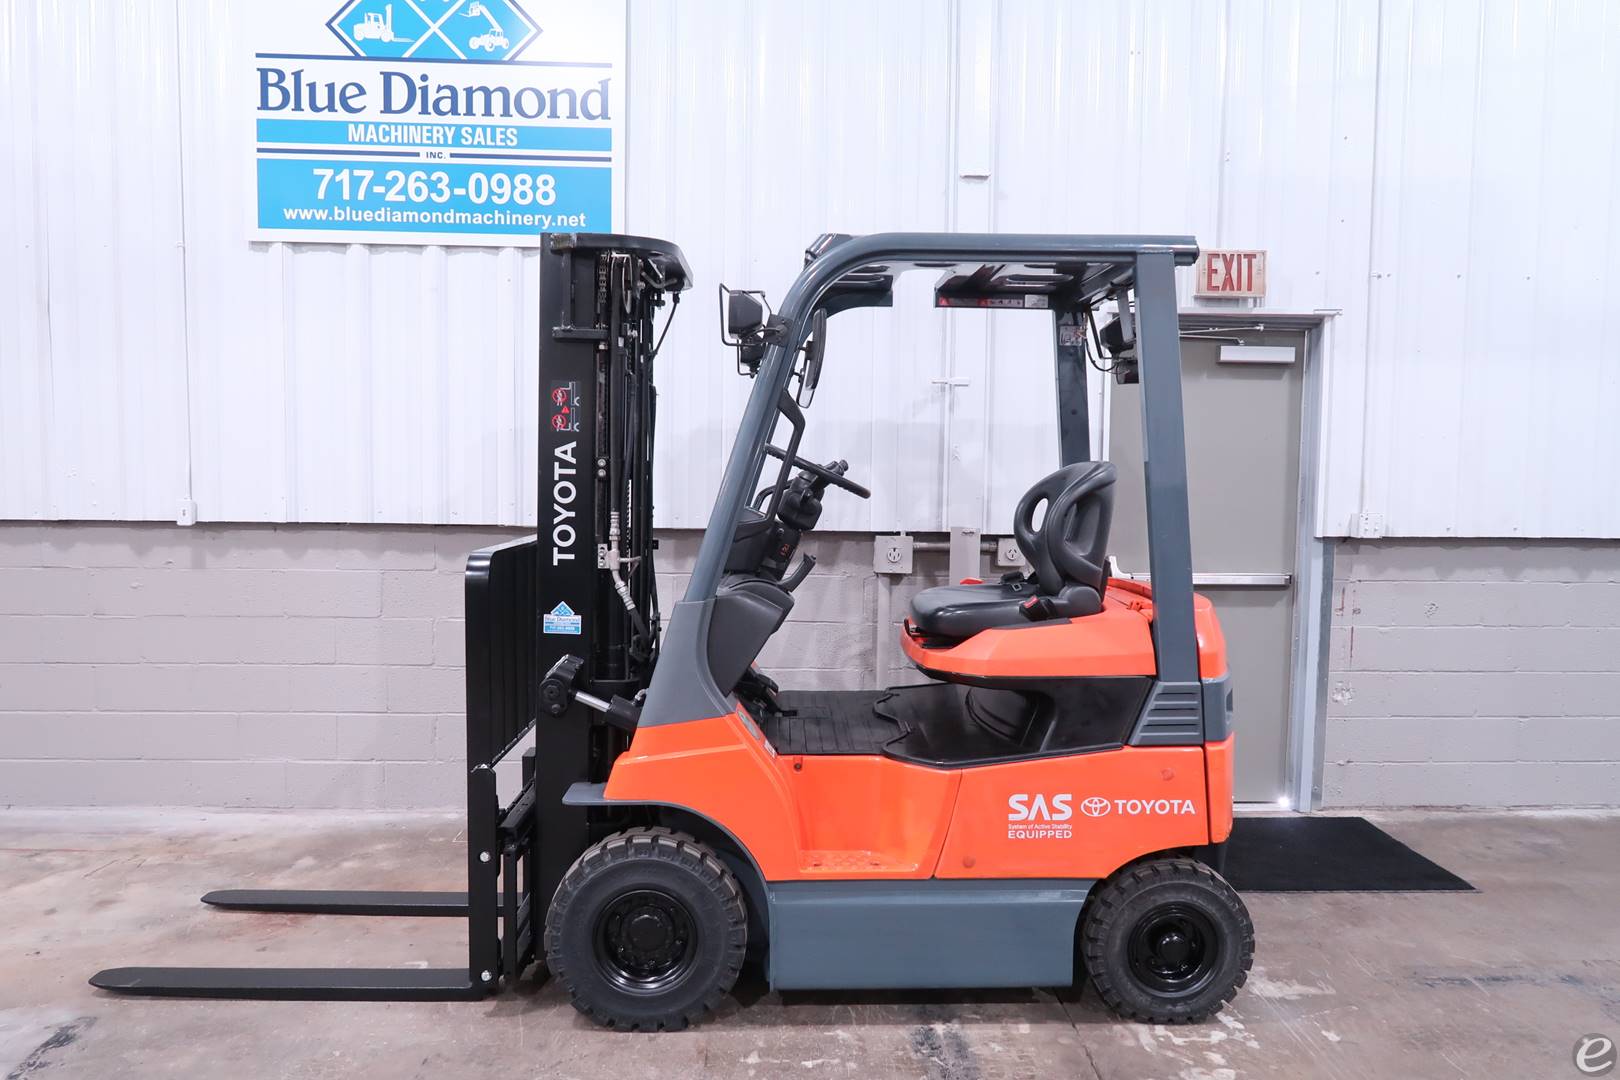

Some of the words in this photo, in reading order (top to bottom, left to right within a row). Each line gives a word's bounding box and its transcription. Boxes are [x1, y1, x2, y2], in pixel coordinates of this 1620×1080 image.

[256, 67, 367, 114] Blue
[379, 71, 611, 121] Diamond
[347, 123, 455, 145] MACHINERY
[460, 127, 519, 147] SALES
[425, 151, 447, 160] INC.
[312, 168, 557, 206] 717-263-0988
[283, 205, 587, 228] www.bluediamondmachinery.net
[1206, 253, 1257, 292] EXIT
[552, 440, 577, 567] TOYOTA
[1008, 793, 1073, 821] SAS
[1114, 799, 1196, 815] TOYOTA
[1008, 830, 1073, 839] EQUIPPED
